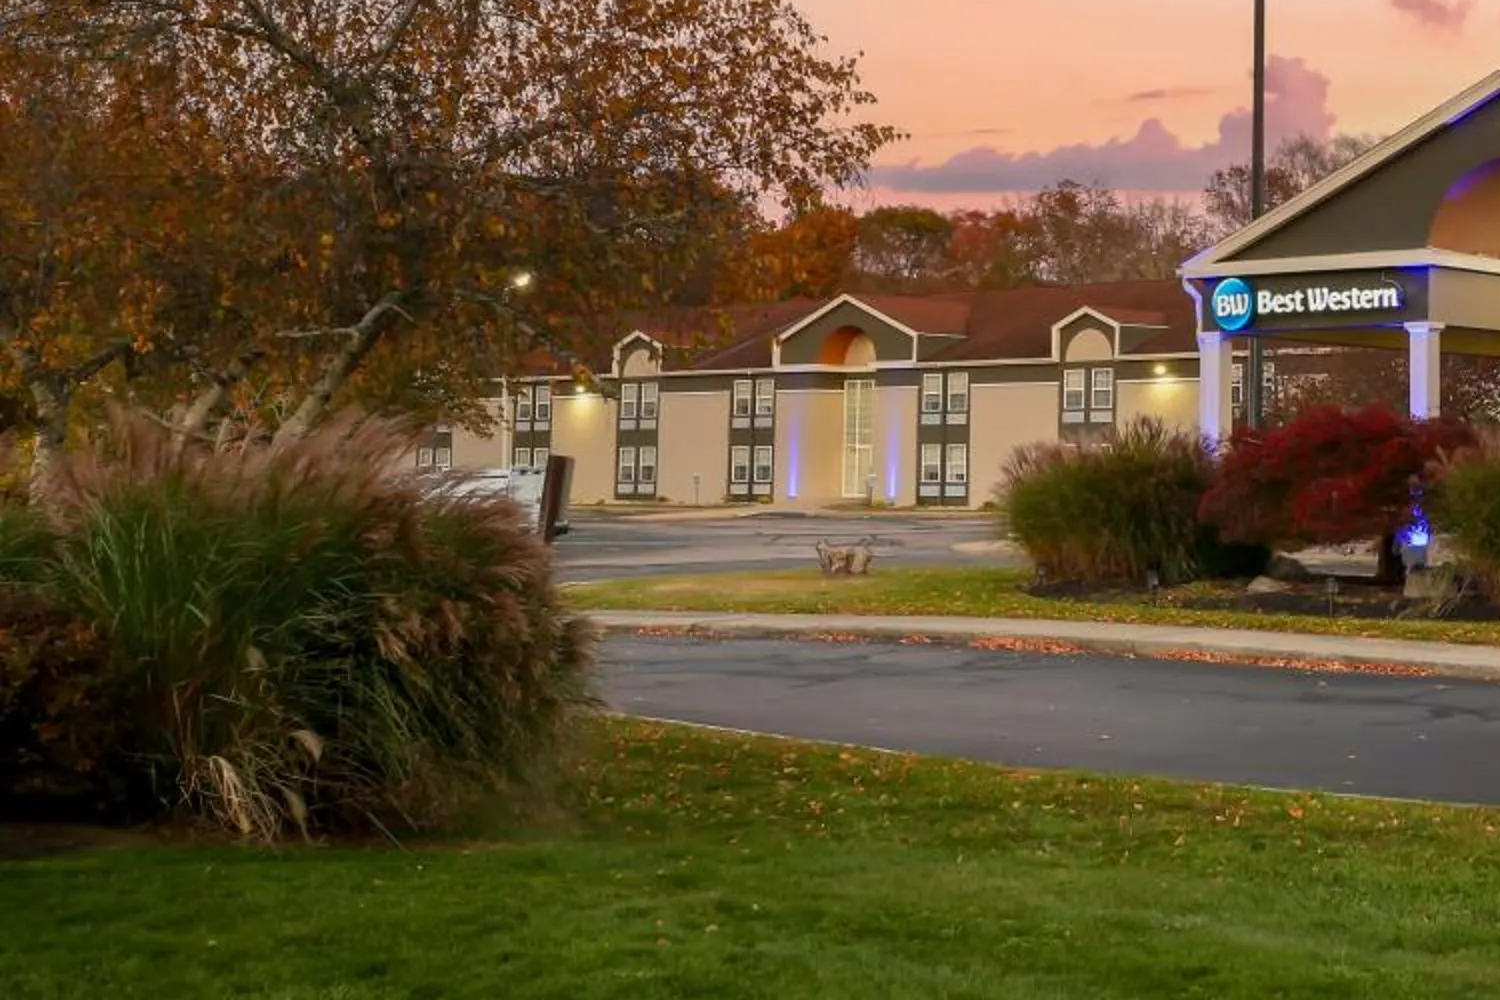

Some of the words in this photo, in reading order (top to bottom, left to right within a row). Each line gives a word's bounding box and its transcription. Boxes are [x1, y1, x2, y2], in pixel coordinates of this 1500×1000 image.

[1217, 293, 1249, 317] BW
[1257, 289, 1305, 314] Best
[1306, 287, 1398, 311] Western
